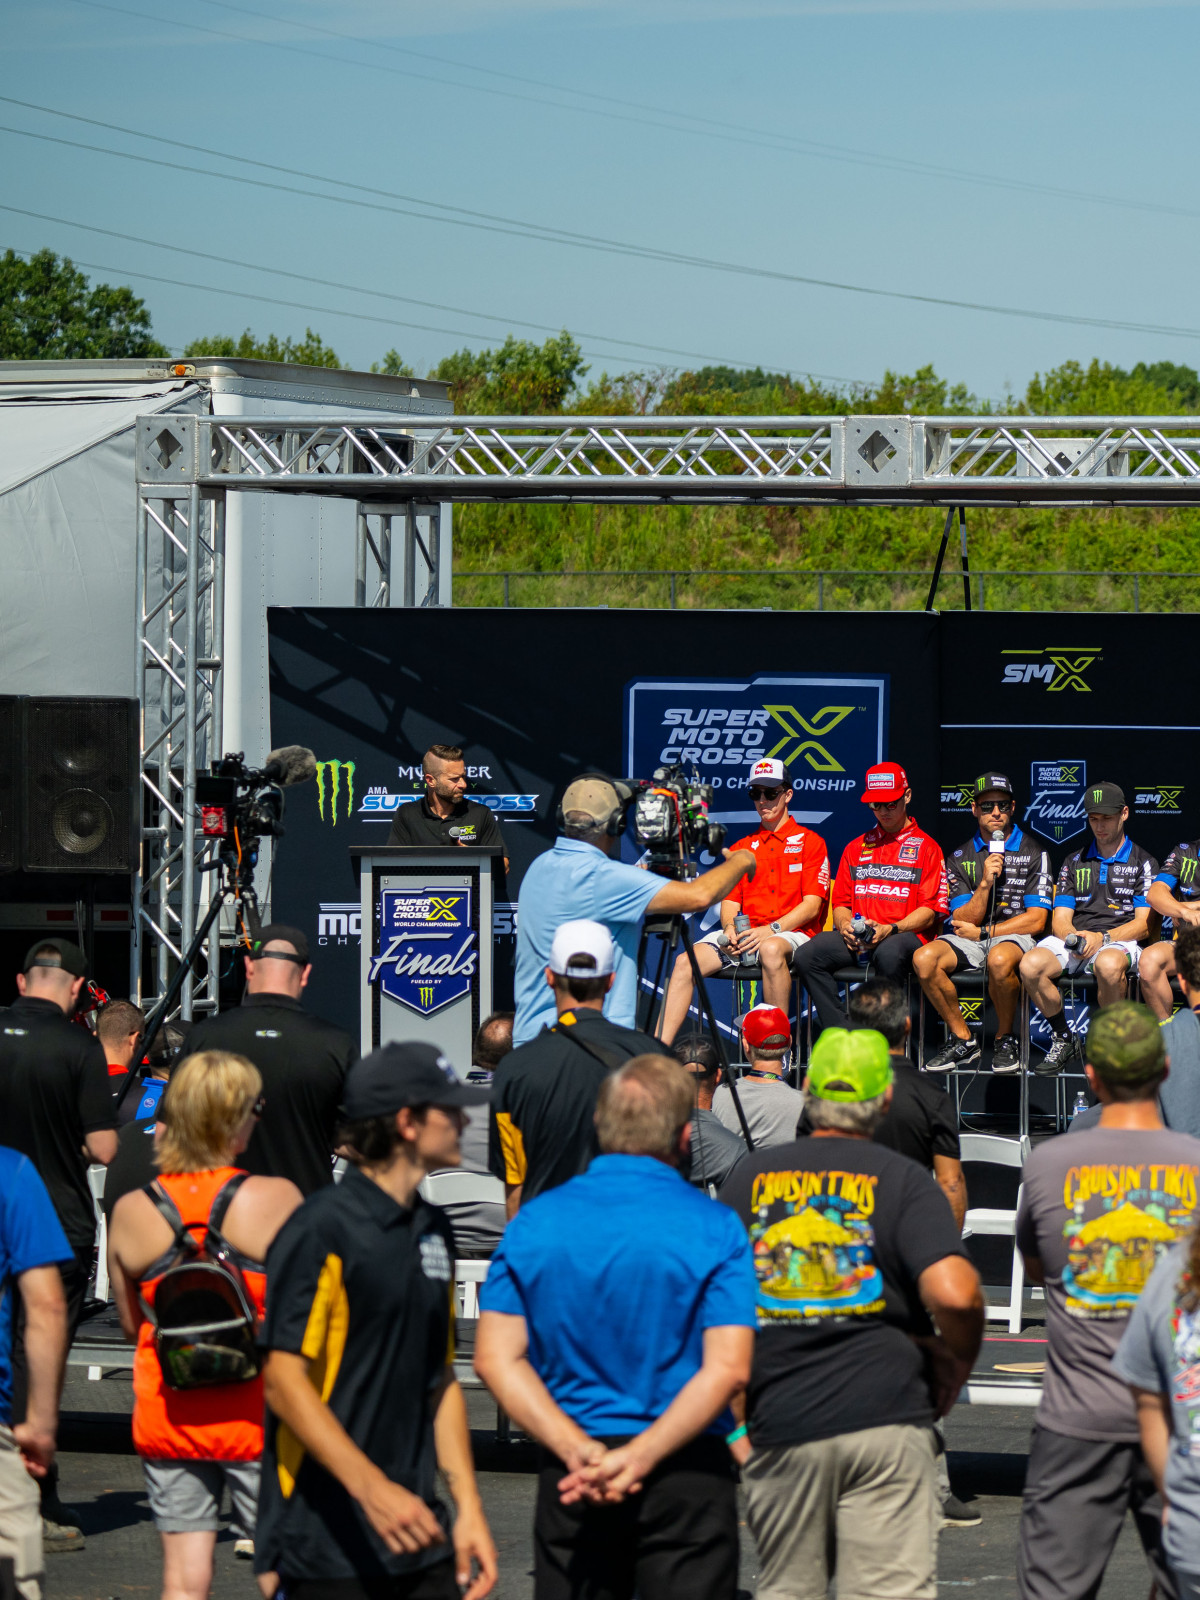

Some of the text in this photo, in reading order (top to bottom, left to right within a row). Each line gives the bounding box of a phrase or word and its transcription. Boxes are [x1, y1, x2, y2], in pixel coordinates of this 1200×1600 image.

[1001, 656, 1095, 692] SMX
[661, 708, 771, 727] SUPER
[667, 728, 764, 746] MOTO
[659, 747, 766, 765] CROSS
[367, 786, 388, 795] AMA
[727, 776, 856, 791] CHONSHIP
[1134, 790, 1181, 808] SMX
[371, 932, 477, 980] Finals
